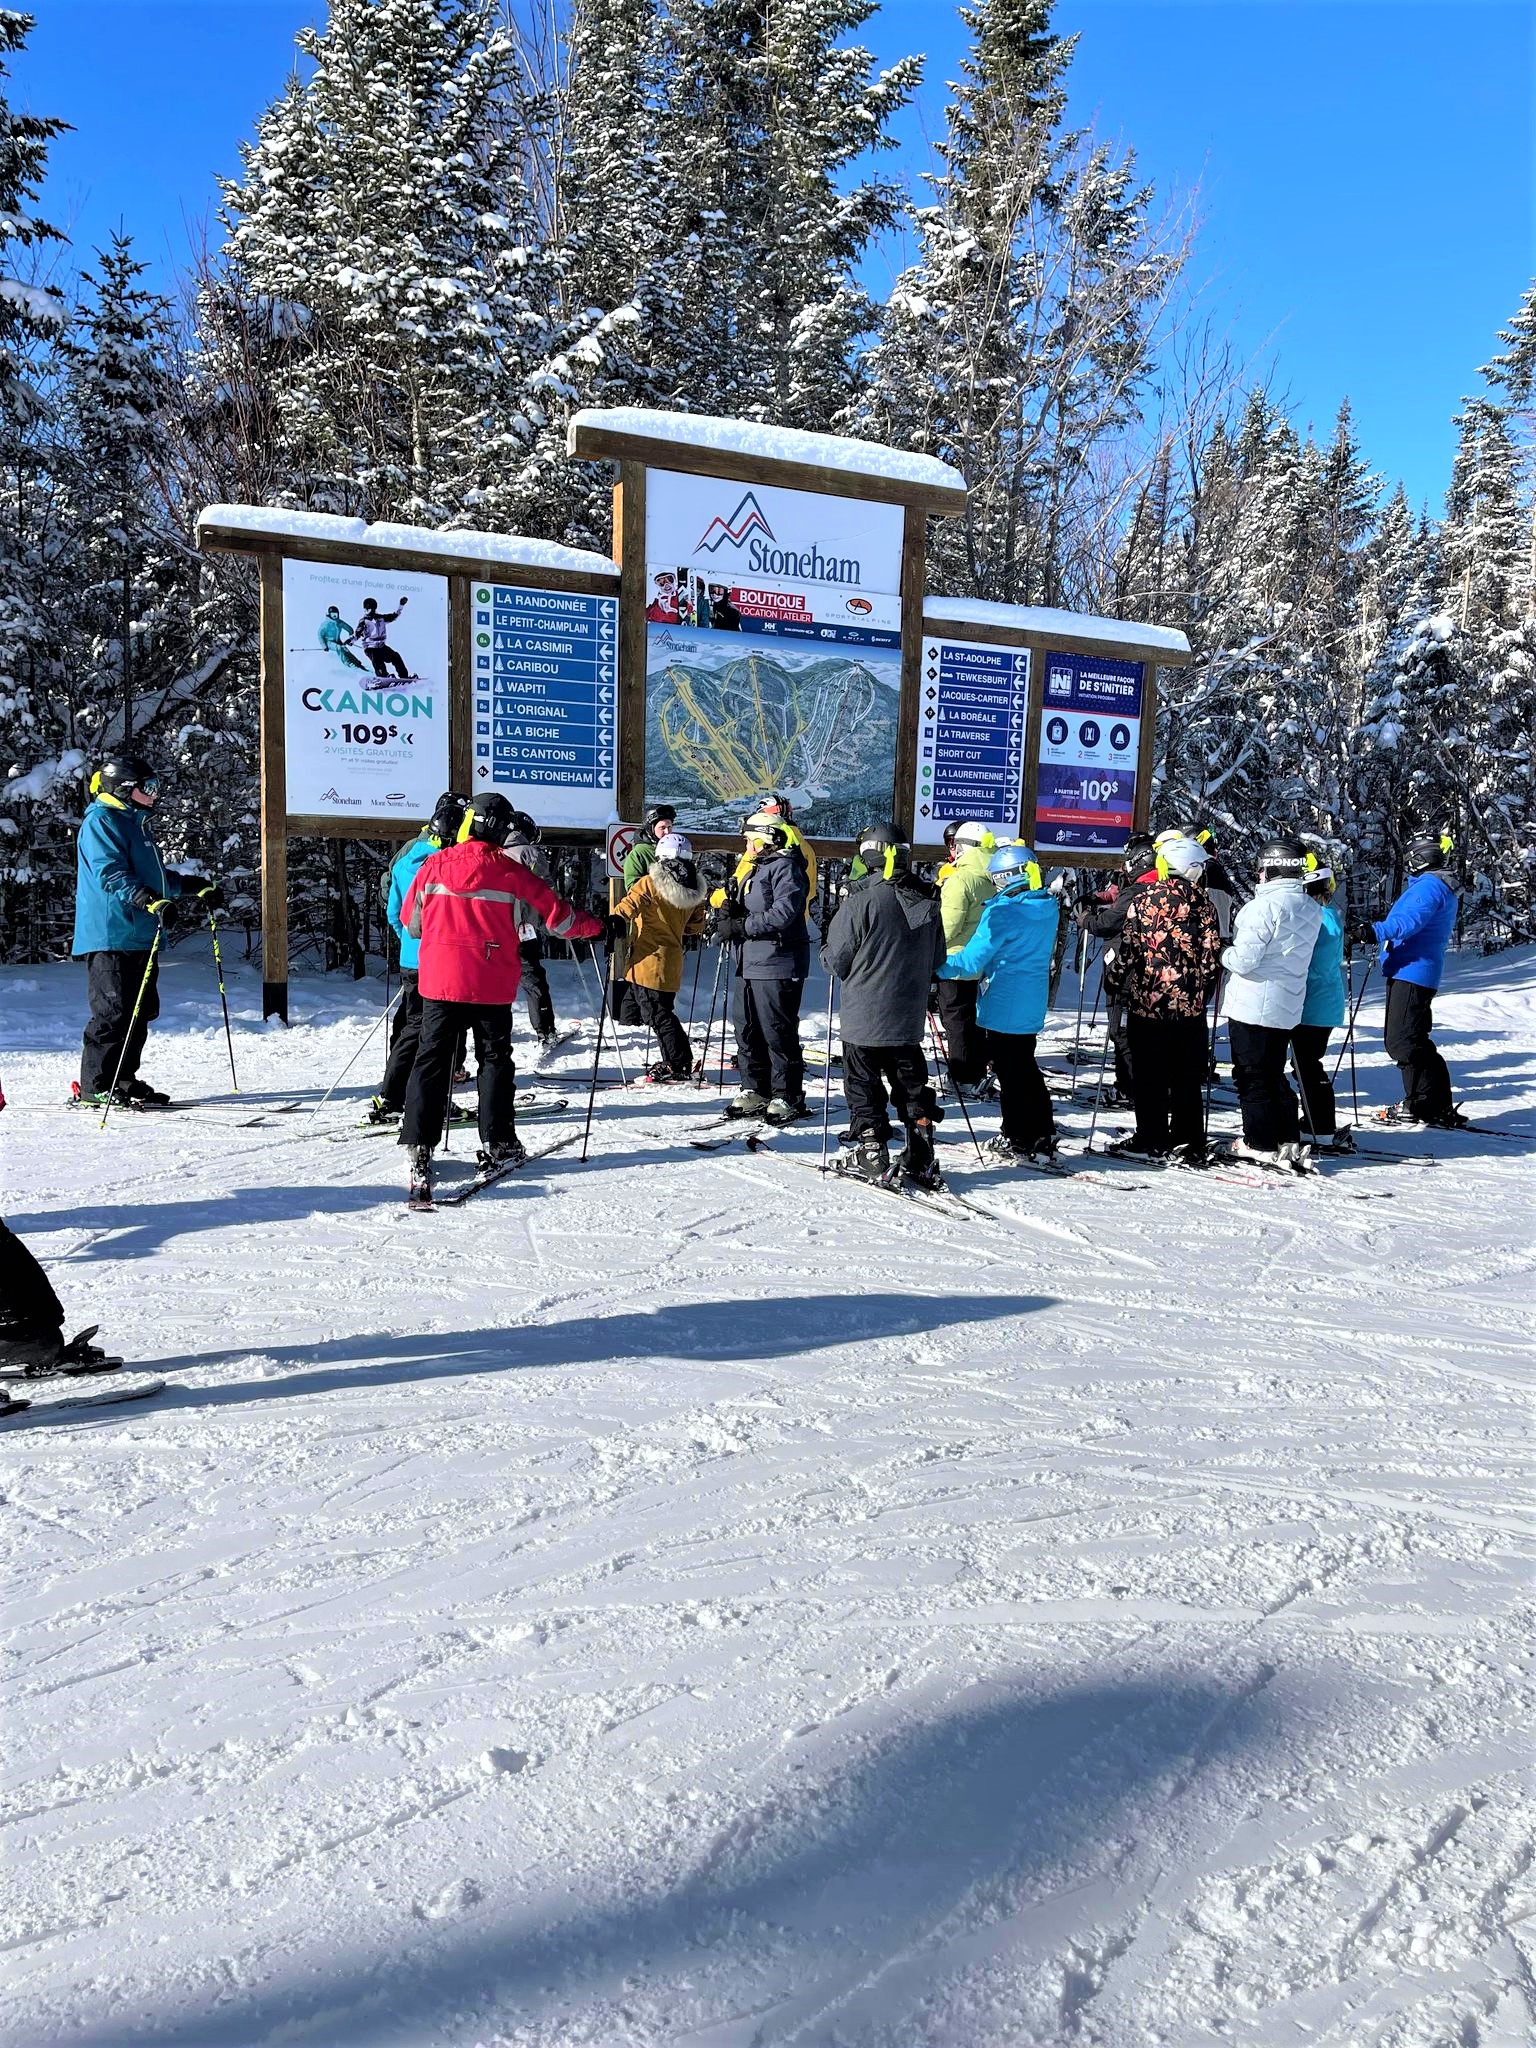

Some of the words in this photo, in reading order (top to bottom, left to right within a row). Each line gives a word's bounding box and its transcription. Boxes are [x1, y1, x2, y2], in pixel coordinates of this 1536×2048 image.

[749, 538, 861, 585] Stoneham
[386, 582, 396, 590] de
[496, 592, 512, 604] LA
[516, 595, 587, 612] RANDONNÉE
[740, 590, 804, 610] BOUTIQUE
[740, 606, 778, 618] LOCATION
[783, 612, 811, 622] ATELIER
[496, 614, 508, 626] LE
[510, 616, 589, 634] PETIT-CHAMPLAIN
[507, 638, 522, 649] LA
[526, 640, 573, 654] CASIMIR
[666, 641, 698, 653] Stoneham
[944, 651, 954, 660] LA
[955, 653, 1002, 665] ST-ADOLPHE
[507, 660, 559, 674] CARIBOU
[956, 672, 1008, 685] TEWKESBURY
[1088, 673, 1116, 682] MEILLEURE
[1117, 676, 1135, 684] FAÇON
[507, 682, 546, 694] WAPITI
[1080, 680, 1092, 691] DE
[941, 691, 1008, 704] JACQUES-CARTIER
[507, 704, 568, 718] L'ORIGNAL
[949, 711, 959, 719] LA
[961, 712, 997, 723] BORÉALE
[341, 723, 398, 745] 109$
[507, 725, 522, 736] LA
[526, 727, 560, 738] BICHE
[939, 730, 949, 738] LA
[951, 730, 990, 741] TRAVERSE
[331, 747, 364, 756] VISITES
[366, 748, 414, 758] GRATUITES
[496, 746, 518, 757] LES
[522, 748, 576, 761] CANTONS
[938, 749, 964, 758] SHORT
[966, 751, 981, 760] CUT
[1078, 750, 1082, 758] 2
[512, 769, 527, 779] LA
[530, 770, 593, 783] STONEHAM
[937, 769, 947, 777] LA
[949, 770, 1004, 781] LAURENTIENNE
[936, 787, 946, 796] LA
[948, 788, 996, 798] PASSERELLE
[1080, 780, 1119, 802] 109$
[332, 796, 362, 806] Stoneham
[944, 808, 954, 816] LA
[955, 808, 994, 818] SAPINIÈRE
